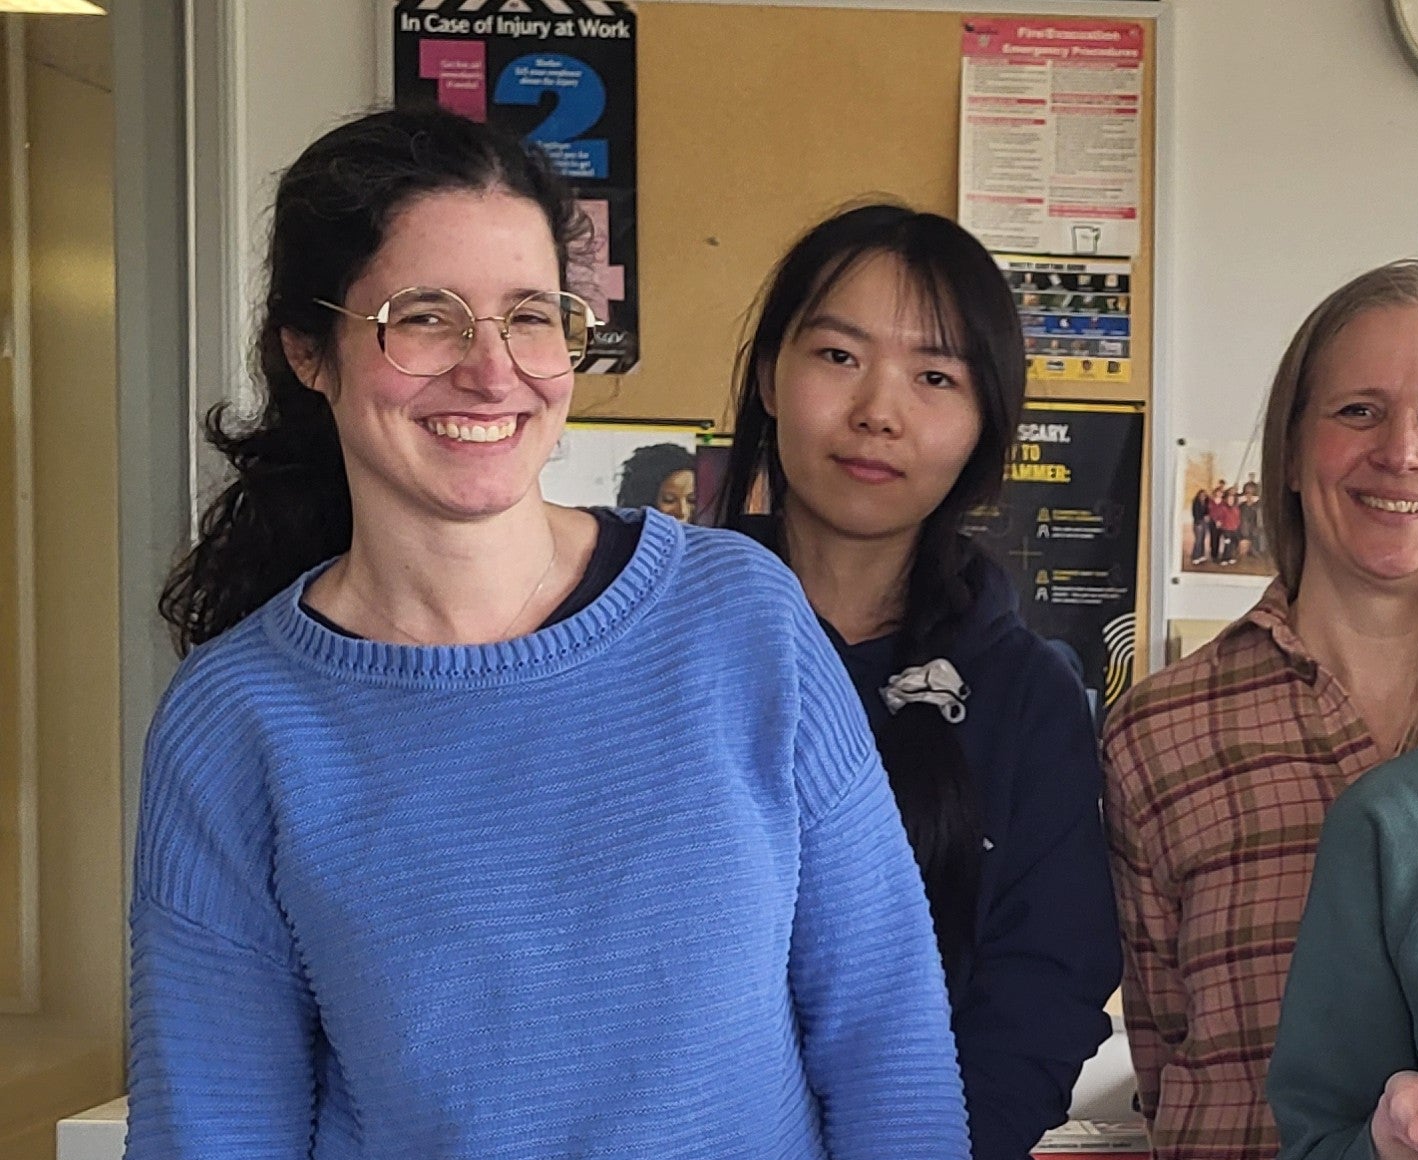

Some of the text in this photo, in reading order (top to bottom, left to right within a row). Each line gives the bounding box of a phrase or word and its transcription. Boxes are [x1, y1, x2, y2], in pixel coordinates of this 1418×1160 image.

[401, 13, 631, 39] In Case of Injury at Work
[493, 53, 609, 178] 2
